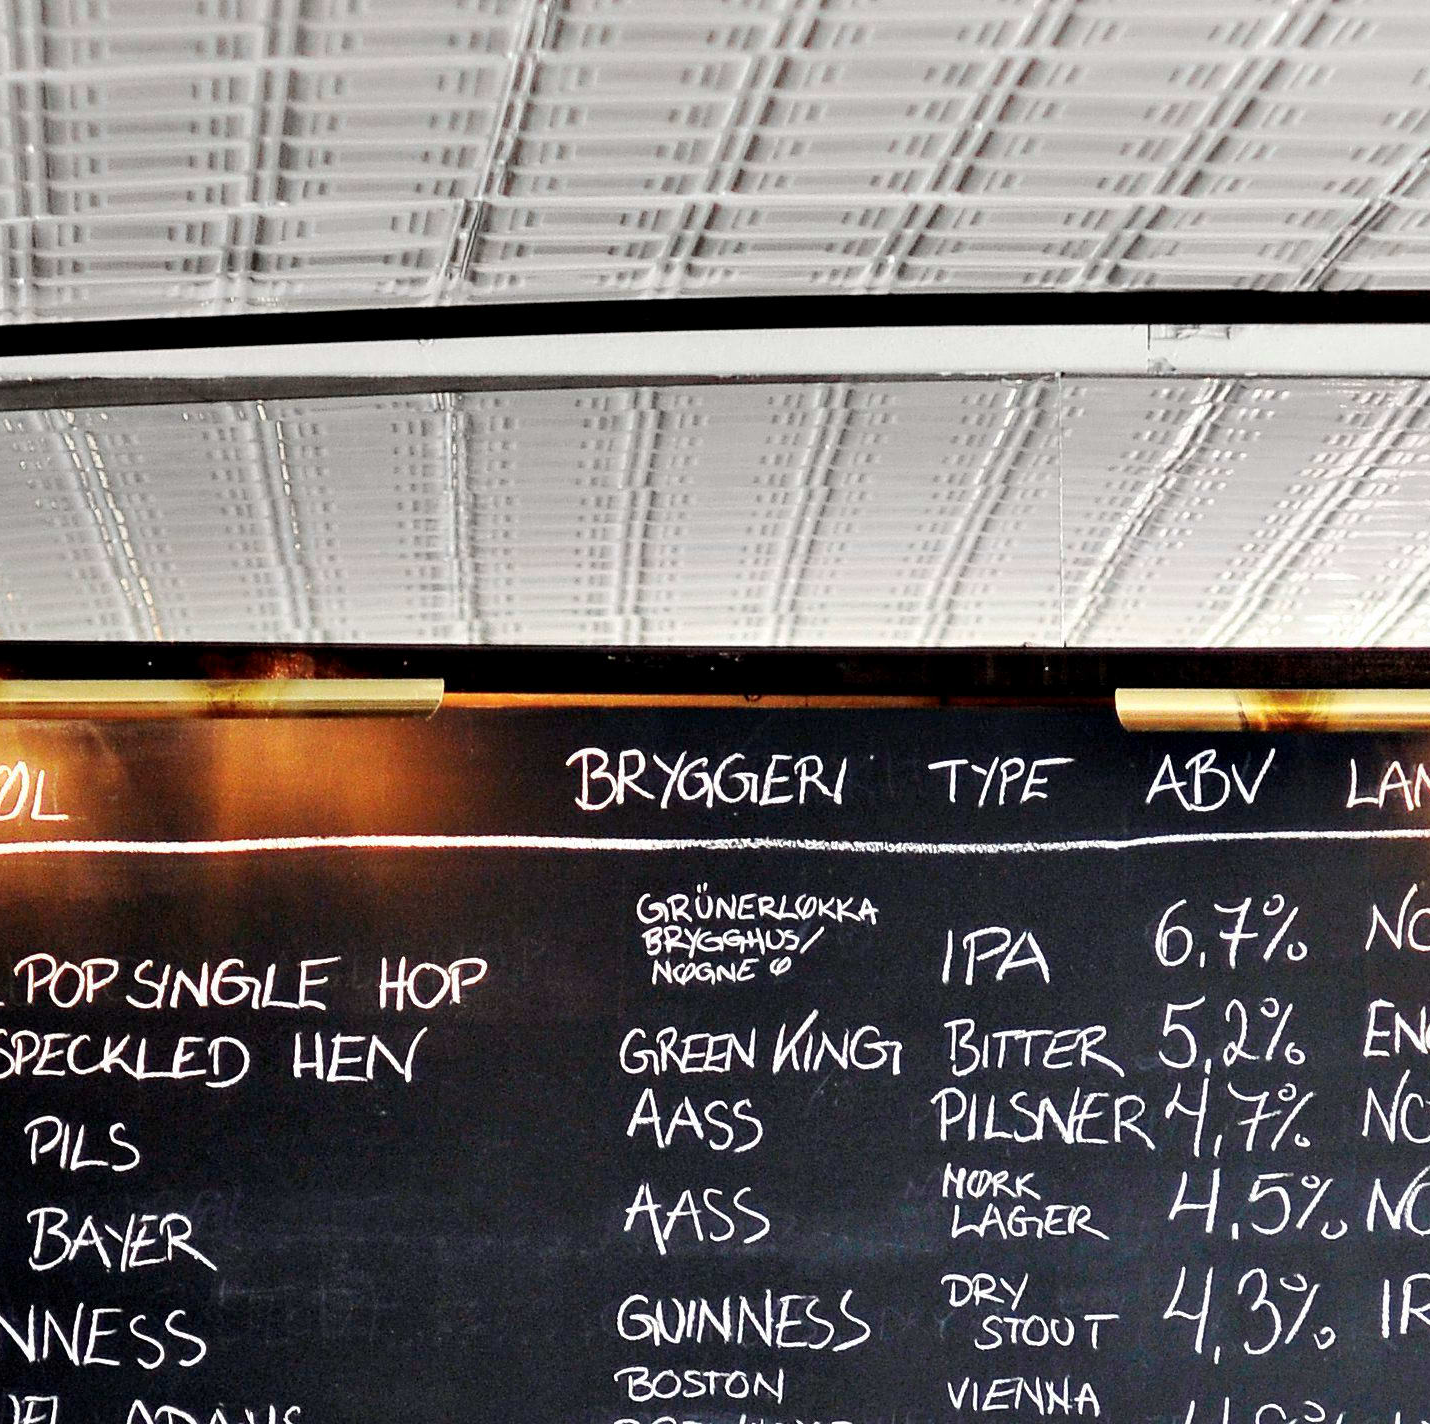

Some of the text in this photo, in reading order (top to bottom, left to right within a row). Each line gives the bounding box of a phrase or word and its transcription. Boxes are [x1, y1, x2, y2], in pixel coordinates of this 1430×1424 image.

[566, 748, 847, 810] BRYGGERI
[928, 756, 1074, 807] TYPE
[1145, 748, 1275, 812] ABV
[637, 882, 879, 925] GRÜNERLØKKA
[1155, 894, 1307, 969] 6,7%
[14, 953, 119, 1008] POP
[126, 956, 341, 1010] SINGLE
[379, 956, 487, 1011] HOP
[652, 958, 759, 985] NØGNE
[942, 927, 1050, 985] IPA
[293, 1027, 427, 1083] HEN
[619, 1009, 902, 1075] GREEN KING
[944, 1019, 1125, 1077] BITTER
[1159, 996, 1305, 1074] 5,2%
[24, 1116, 140, 1171] PILS
[627, 1088, 763, 1152] AASS
[930, 1087, 1155, 1150] PILSNER
[1165, 1078, 1314, 1157] 4,7%
[942, 1163, 1041, 1200] MØRK
[1168, 1168, 1348, 1240] 4,5%
[27, 1207, 217, 1272] BAYER
[624, 1183, 770, 1255] AASS
[952, 1203, 1109, 1240] LAGER
[617, 1289, 871, 1352] GUINNESS
[941, 1273, 1028, 1311] DRY
[1163, 1267, 1336, 1364] 4,3%
[974, 1314, 1119, 1350] STOUT
[614, 1367, 784, 1404] BOSTON
[948, 1377, 1100, 1417] VIENNA
